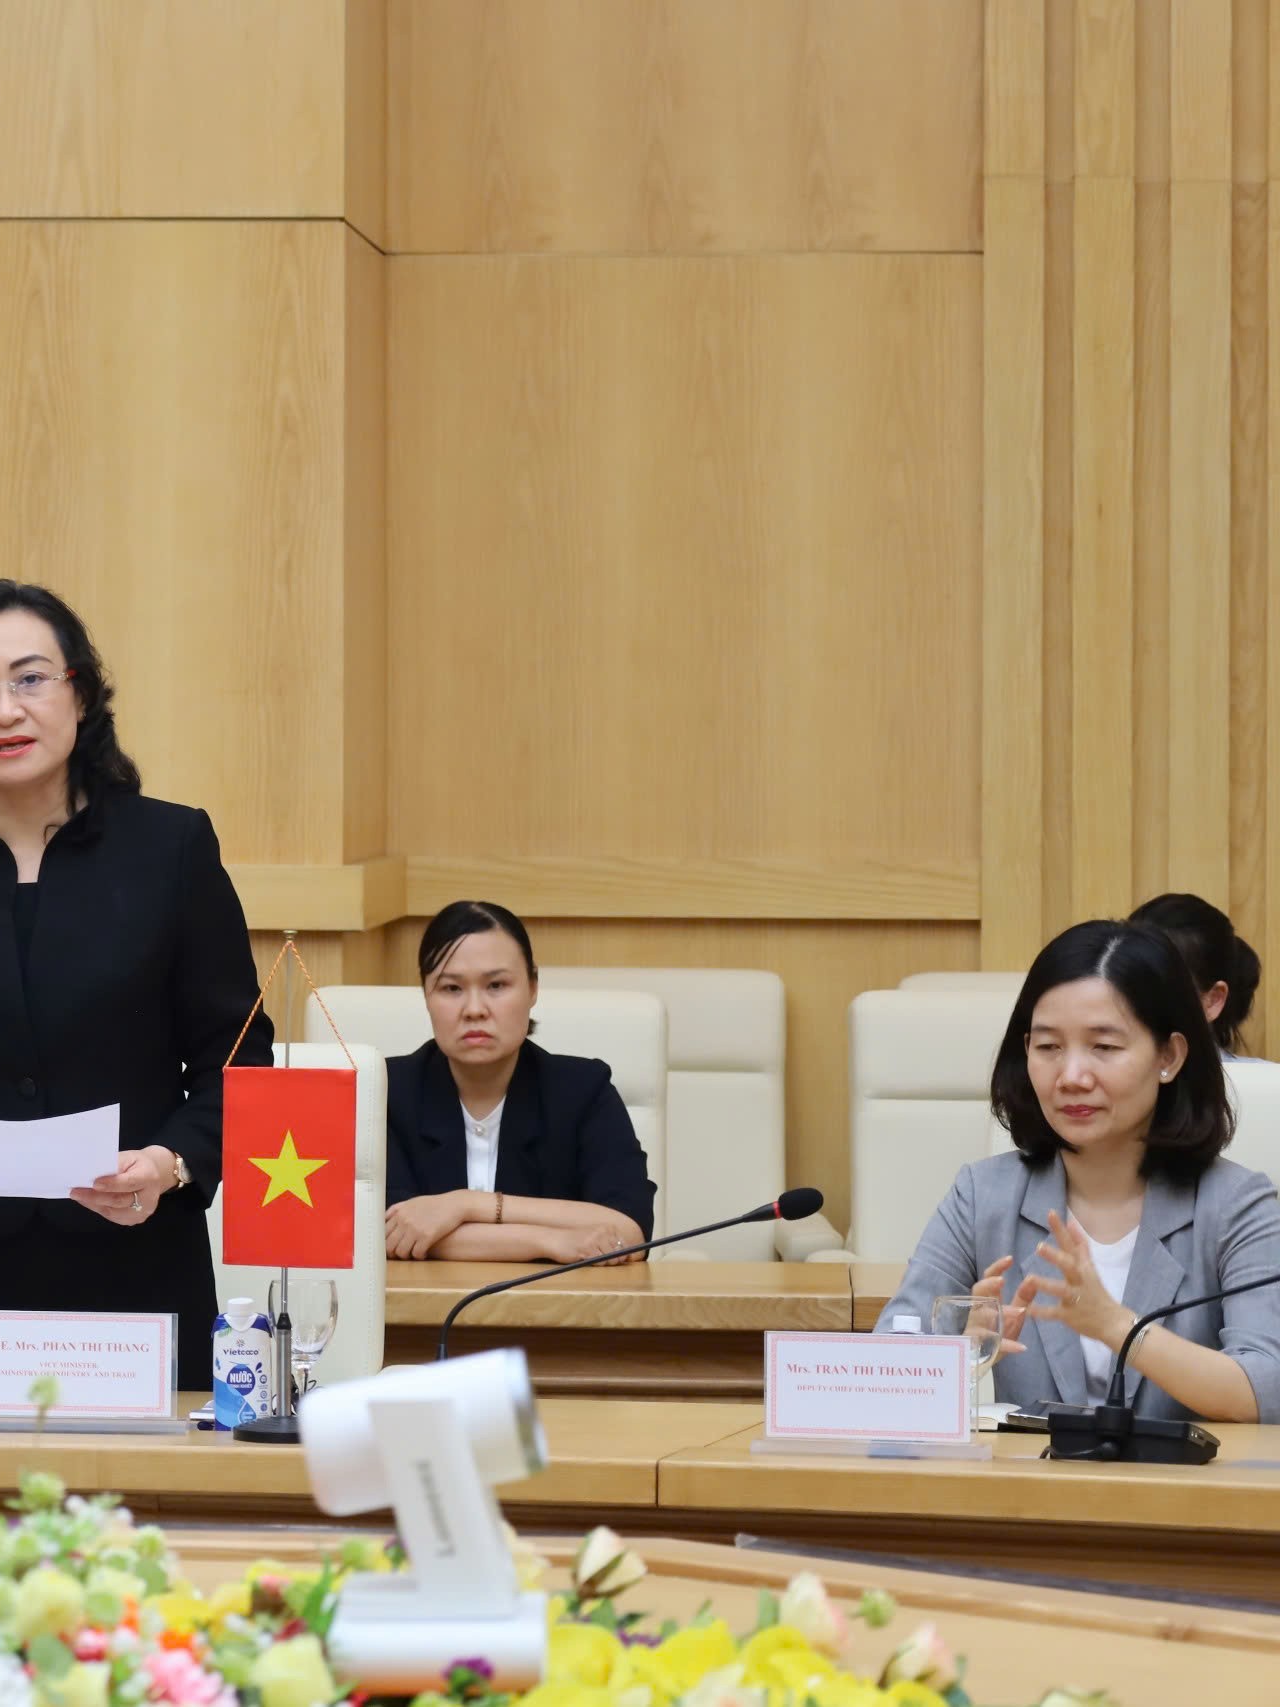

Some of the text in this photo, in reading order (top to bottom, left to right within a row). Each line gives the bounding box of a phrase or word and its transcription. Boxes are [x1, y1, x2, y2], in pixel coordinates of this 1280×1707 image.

[15, 1341, 39, 1351] Mrs.
[43, 1341, 76, 1351] PHAN
[80, 1342, 102, 1352] THI
[106, 1342, 150, 1352] THANG
[223, 1348, 259, 1356] Vietcoco
[787, 1363, 945, 1377] Mrs. TRAN THI THANH MY
